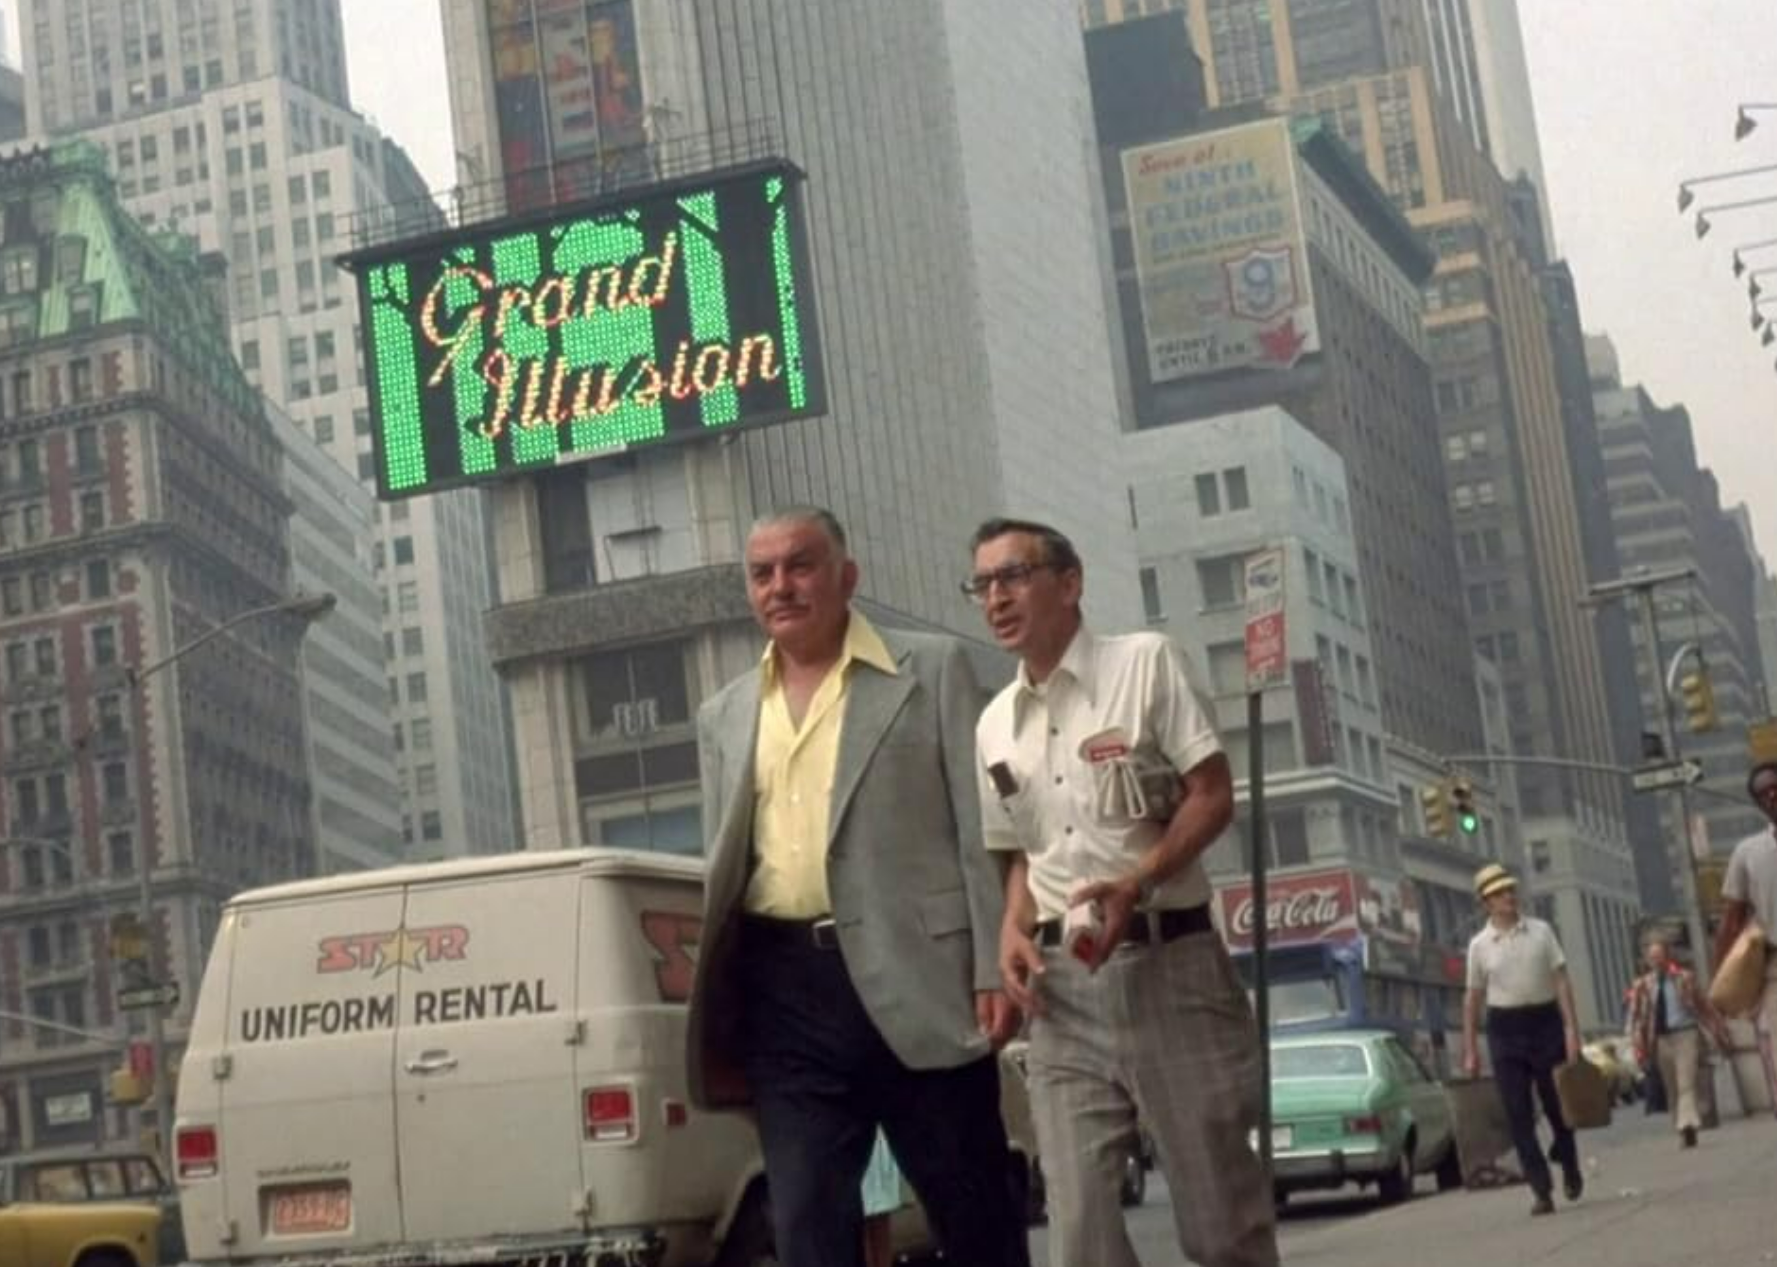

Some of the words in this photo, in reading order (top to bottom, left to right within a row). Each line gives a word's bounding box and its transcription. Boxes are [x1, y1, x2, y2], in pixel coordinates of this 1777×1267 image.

[421, 231, 677, 387] Grand
[1244, 258, 1276, 312] 9
[476, 333, 782, 440] Illusion
[241, 993, 395, 1042] UNIFORM
[414, 979, 558, 1025] RENTAL
